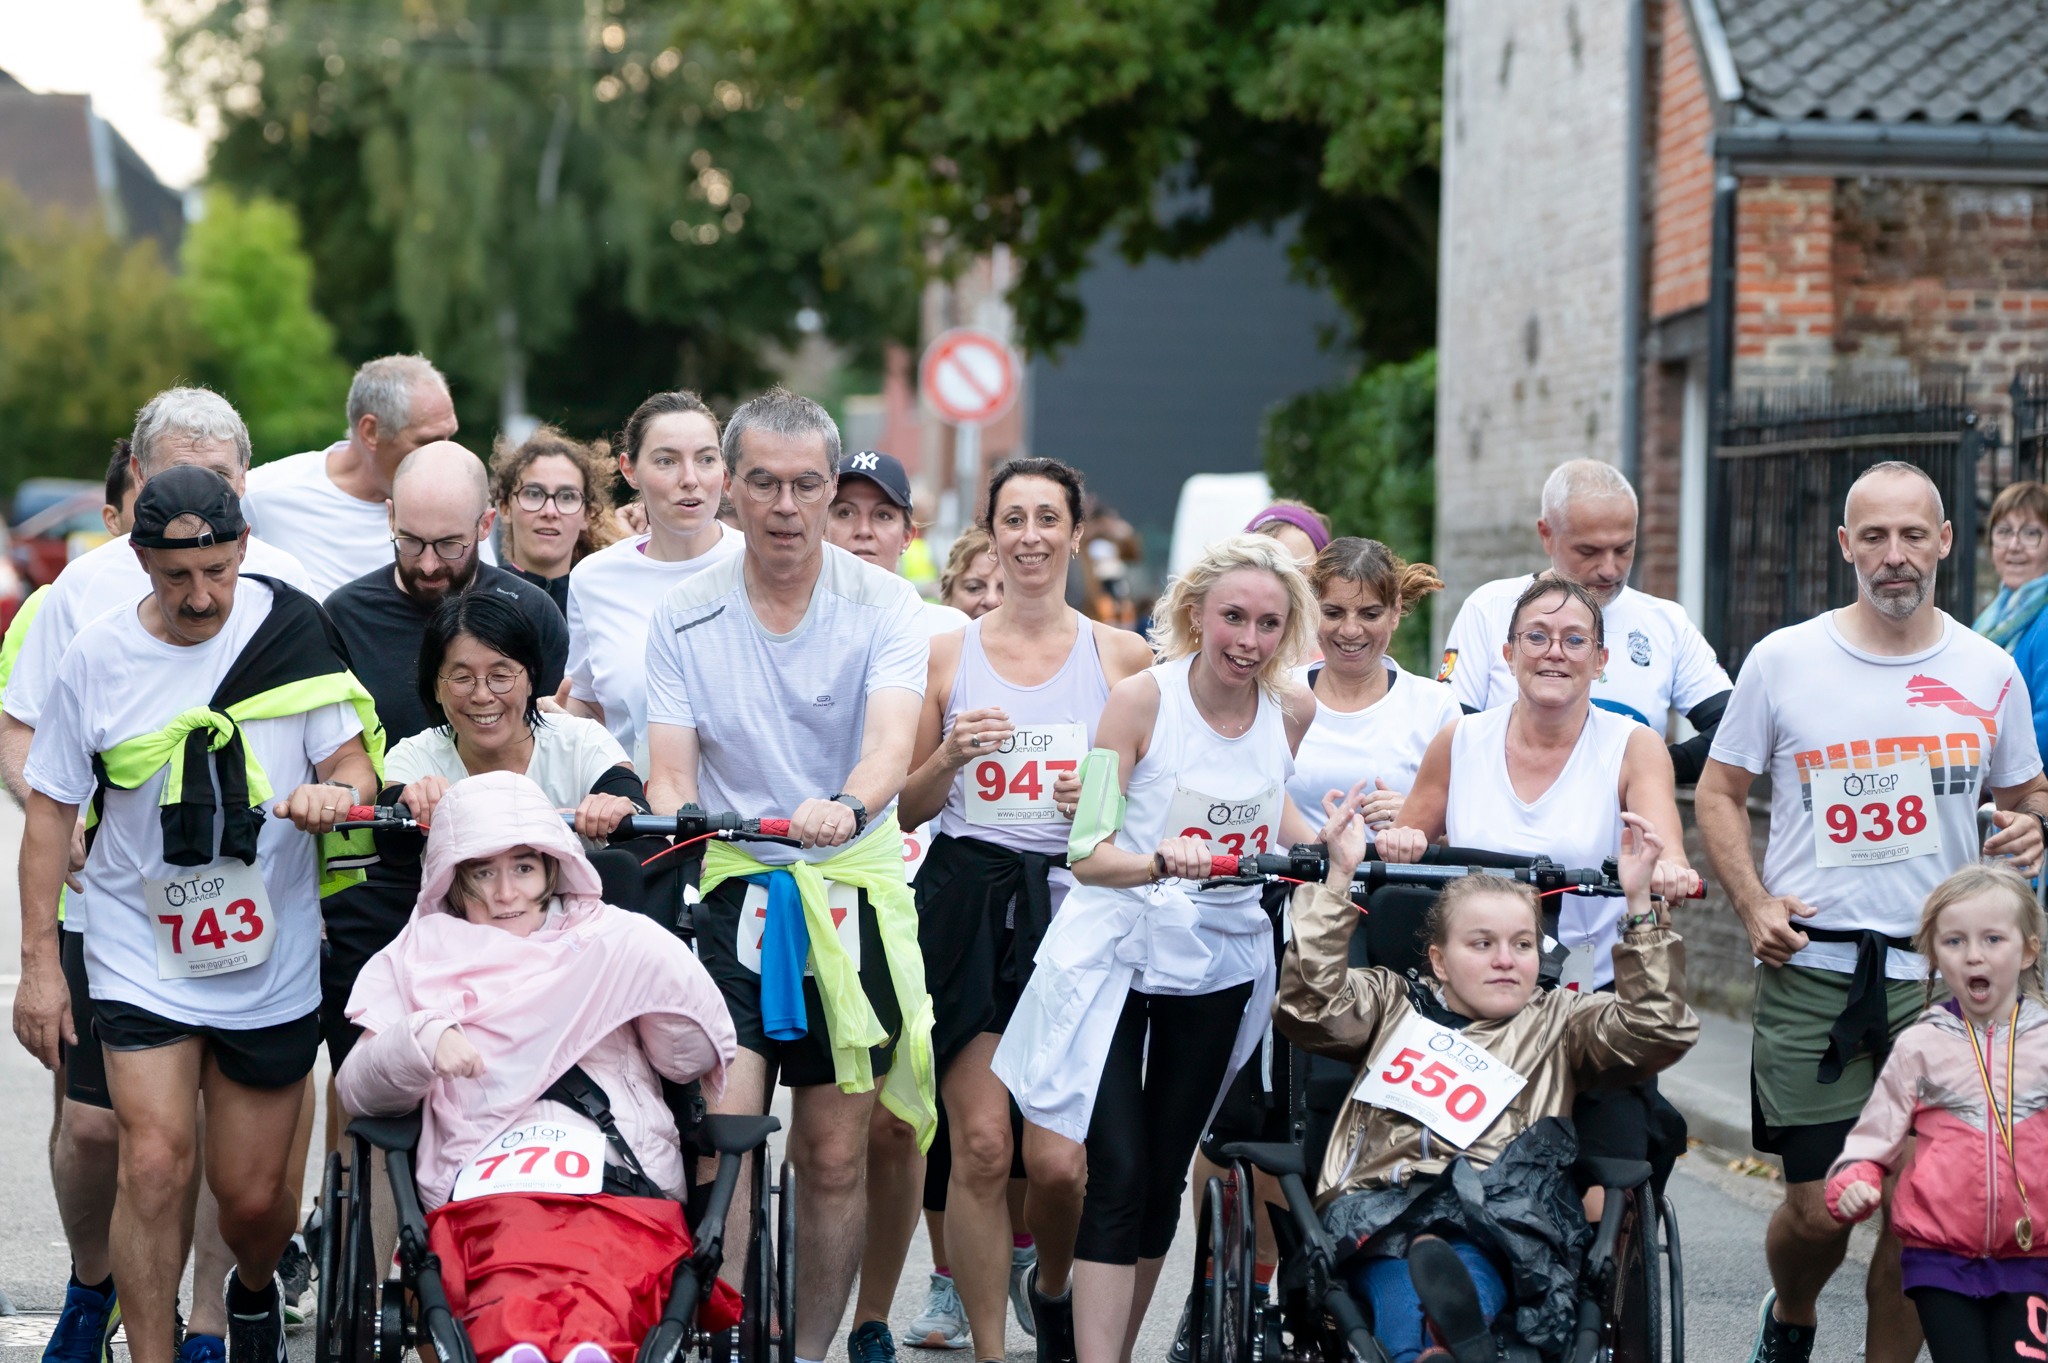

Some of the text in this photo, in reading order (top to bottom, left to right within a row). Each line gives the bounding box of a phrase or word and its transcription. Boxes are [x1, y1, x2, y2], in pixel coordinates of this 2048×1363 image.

[1826, 795, 1927, 844] 938
[185, 891, 218, 905] Services
[157, 898, 264, 954] 743
[1382, 1047, 1487, 1123] 550
[475, 1146, 590, 1181] 770
